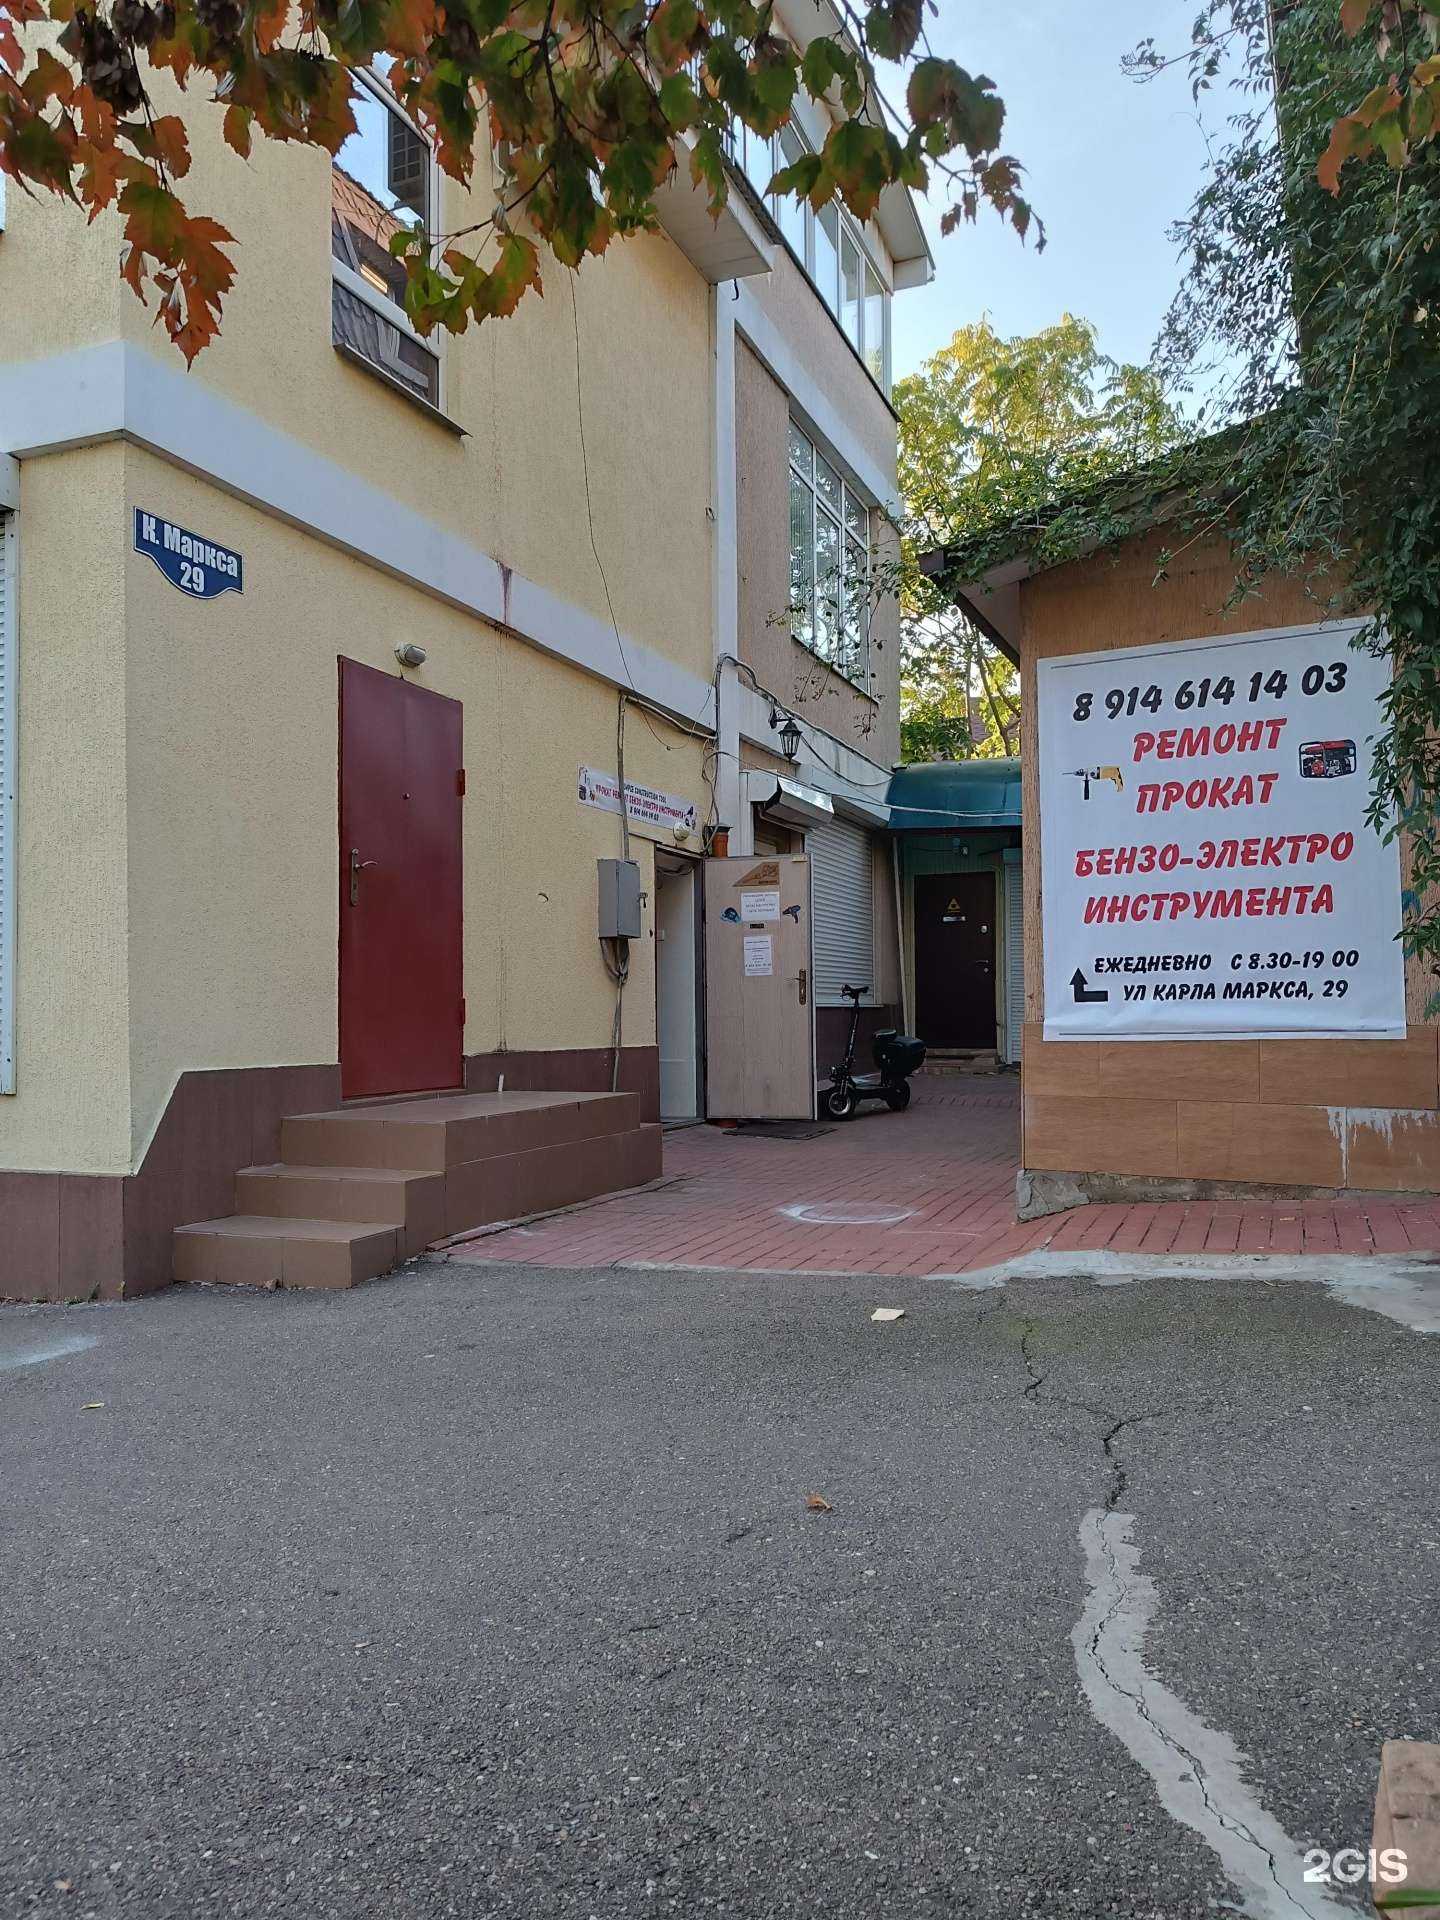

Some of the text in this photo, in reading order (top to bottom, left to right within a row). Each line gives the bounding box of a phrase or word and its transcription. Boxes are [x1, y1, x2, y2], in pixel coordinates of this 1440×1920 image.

[142, 513, 239, 578] К. Маркса
[180, 561, 205, 593] 29
[1072, 661, 1348, 722] 8 914 614 14 03
[1133, 718, 1287, 763] РЕМОНТ
[1136, 773, 1280, 814] ПРОКАТ
[1074, 832, 1355, 878] БЕНЗО-ЭЛЕКТРО
[1084, 884, 1335, 924] ИНСТРУМЕНТА
[1094, 949, 1360, 974] ЕЖЕДНЕВНО С 8.30-19 00
[1123, 979, 1349, 1002] УЛ КАРЛА МАРКСА, 29
